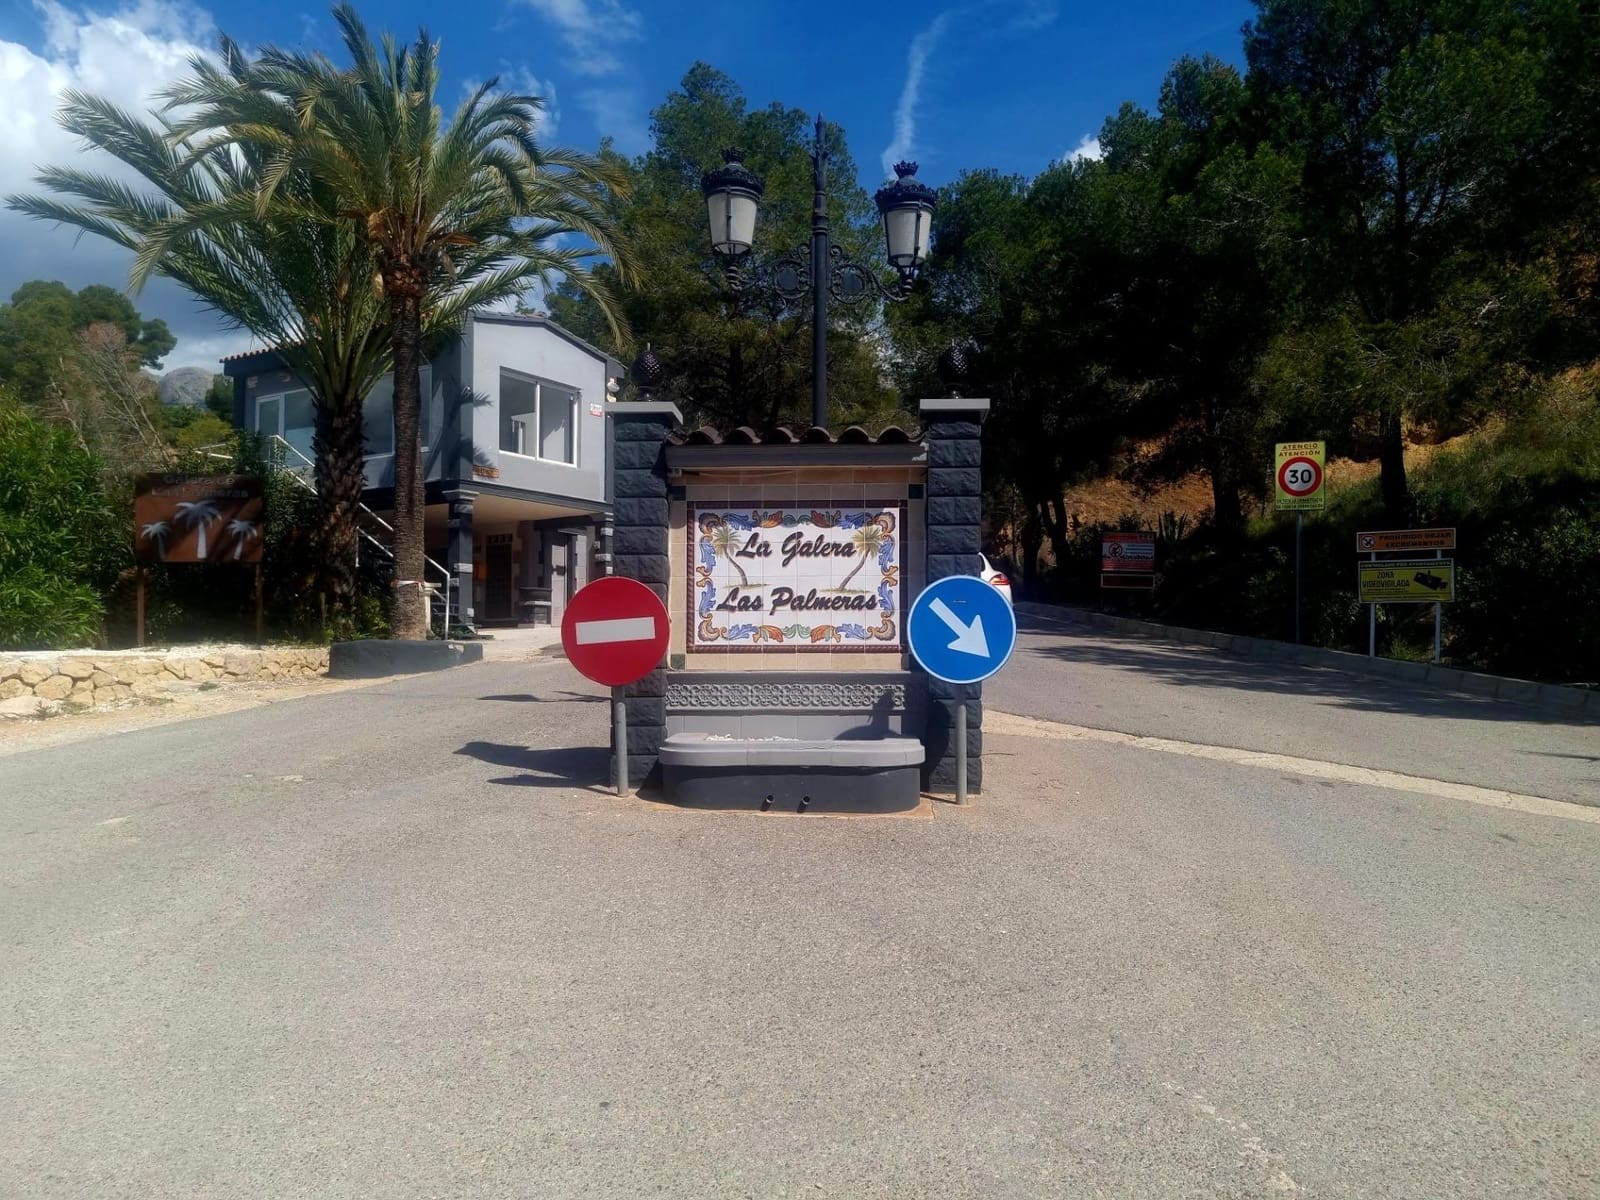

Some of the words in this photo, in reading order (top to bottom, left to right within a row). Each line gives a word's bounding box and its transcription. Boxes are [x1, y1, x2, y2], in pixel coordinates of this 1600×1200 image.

[1289, 469, 1312, 484] 30
[736, 532, 772, 558] La
[781, 531, 857, 567] Galera
[716, 587, 764, 612] Las
[769, 586, 879, 616] Palmeras
